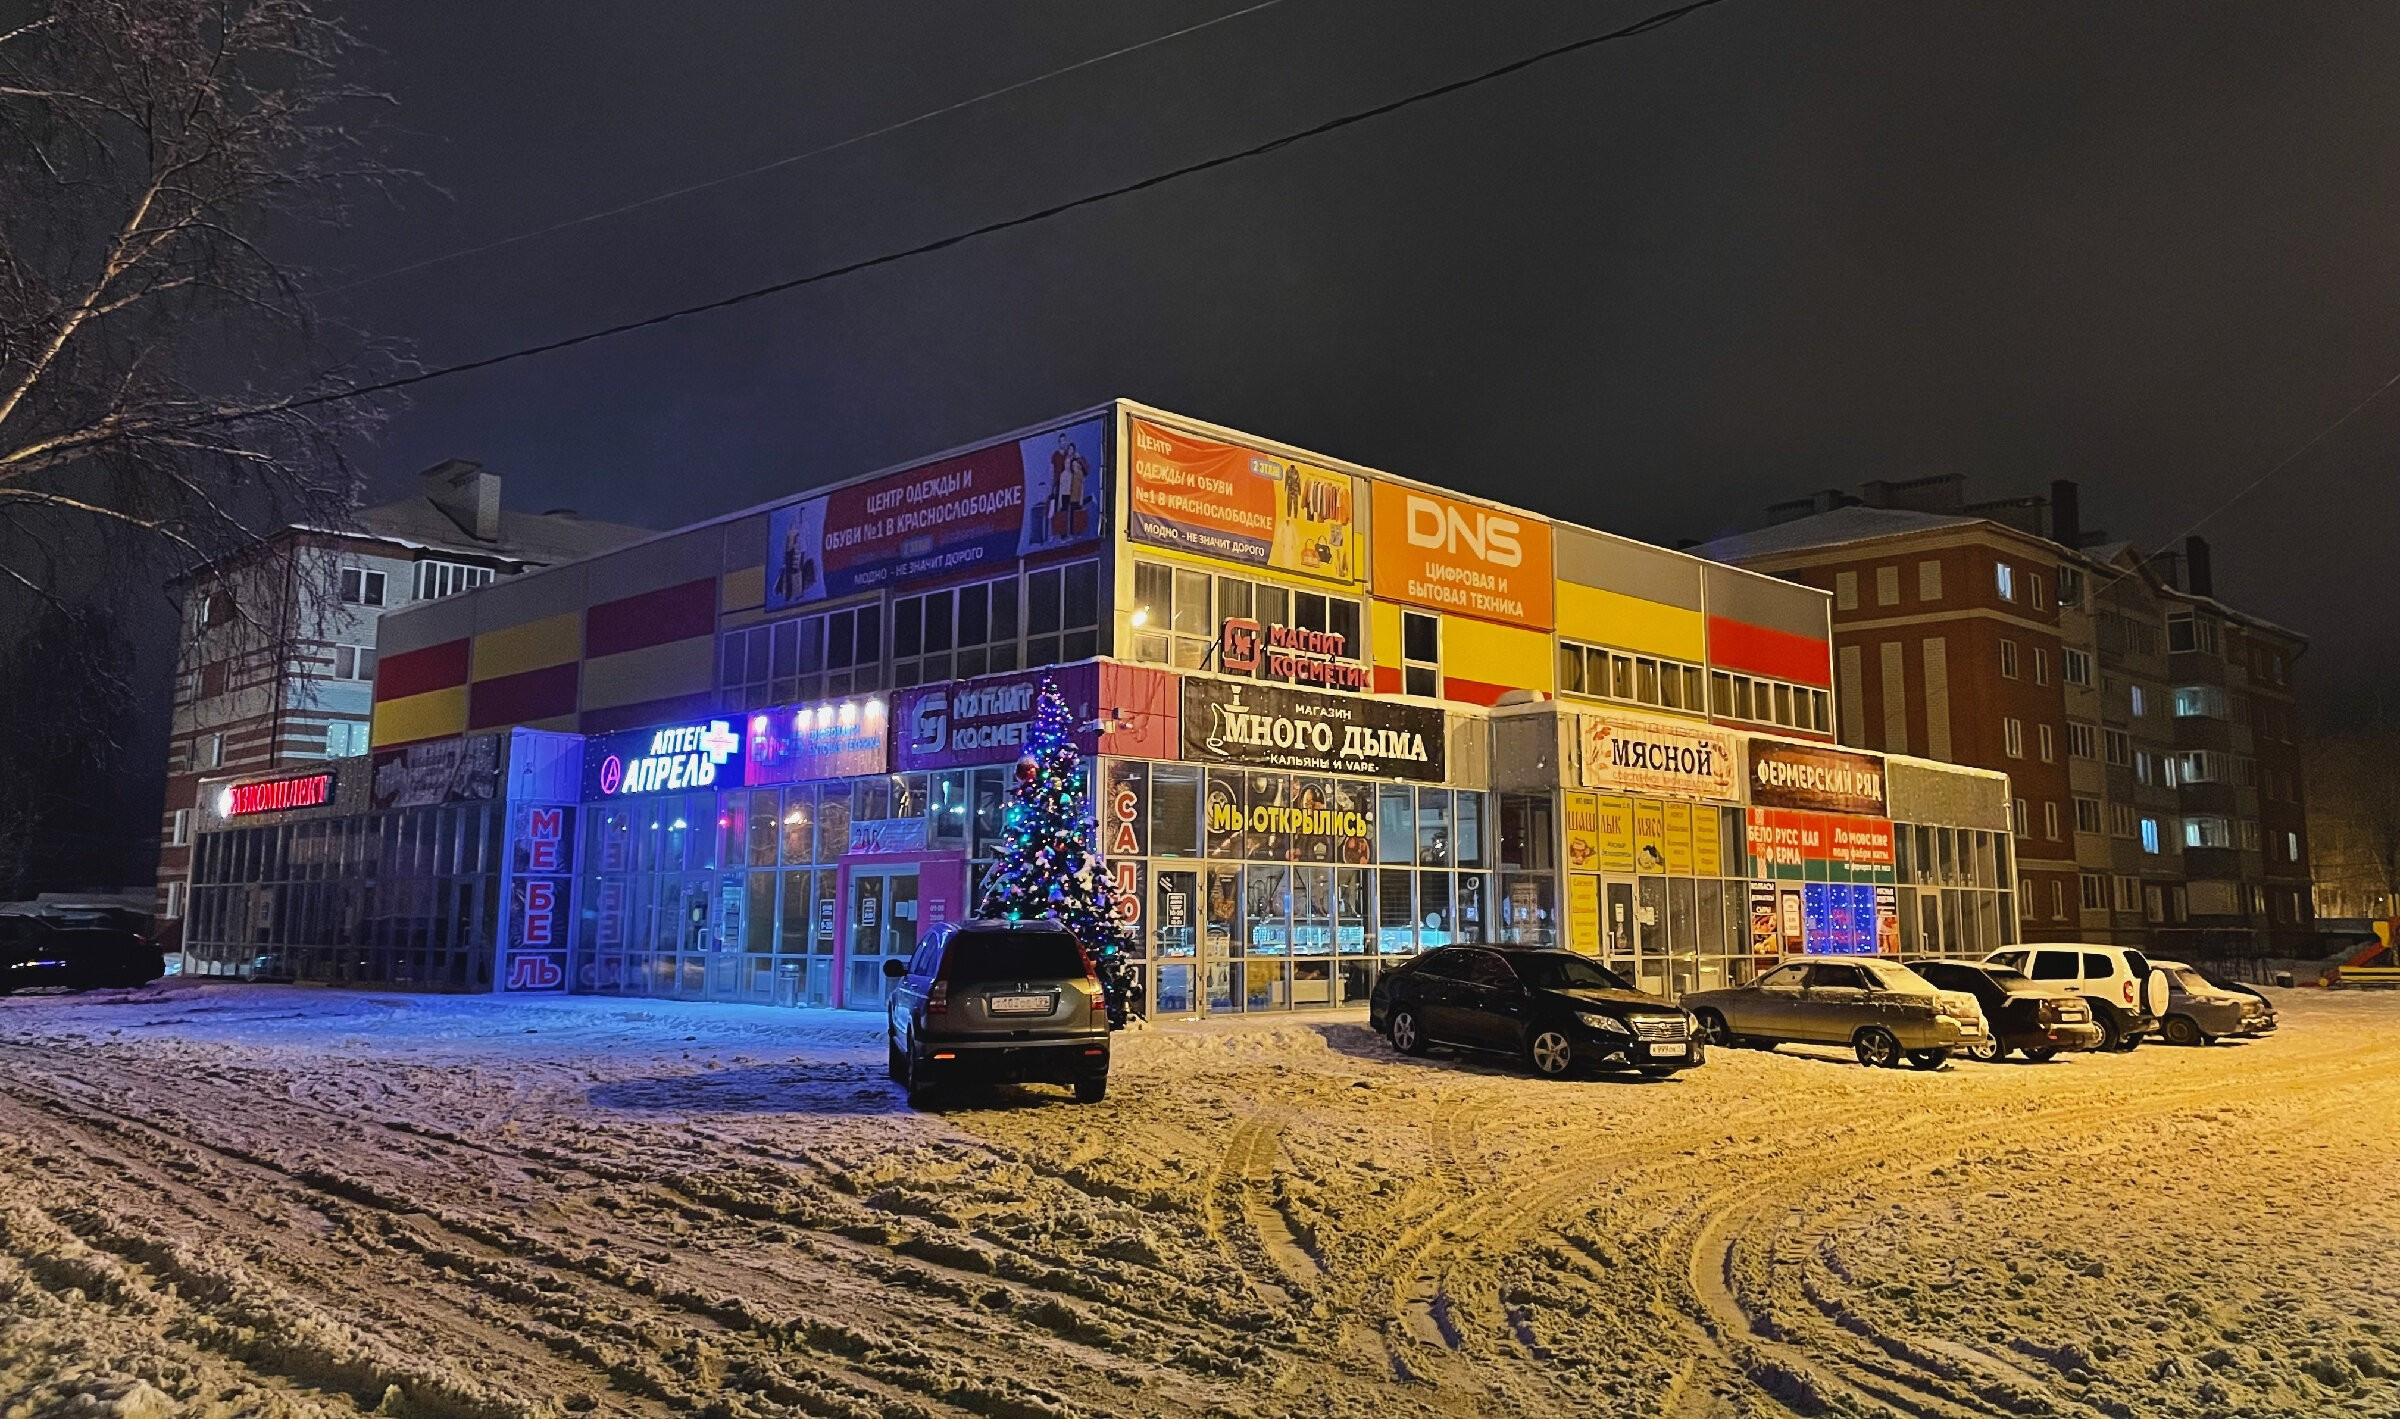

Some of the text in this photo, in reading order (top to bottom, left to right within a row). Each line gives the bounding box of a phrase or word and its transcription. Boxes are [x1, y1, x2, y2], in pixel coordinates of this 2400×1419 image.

[1137, 432, 1171, 455] ЦЕНТР
[1136, 460, 1233, 496] ОДЕЖДЫ И ОБУВИ
[1253, 461, 1259, 471] 2
[867, 470, 972, 515] ЦЕНТР ОДЕЖДЫ И
[1136, 486, 1273, 530] №1 В КРАСНОСЛОБОДСКЕ
[825, 525, 861, 551] ОБУВИ
[864, 522, 883, 542] №1
[886, 517, 894, 536] В
[897, 485, 1022, 534] КРАСНОСЛОБОДСКЕ
[1407, 495, 1522, 568] DNS
[1144, 523, 1178, 538] МОДНО
[1187, 532, 1198, 543] НЕ
[1199, 535, 1230, 550] ЗНАЧИТ
[1232, 542, 1265, 557] ДОРОГО
[854, 568, 887, 585] МОДНО
[896, 563, 907, 576] НЕ
[908, 555, 943, 574] ЗНАЧИТ
[945, 547, 983, 567] ДОРОГО
[1425, 562, 1508, 593] ЦИФРОВАЯ И
[1408, 580, 1524, 617] БЫТОВАЯ ТЕХНИКА
[1270, 624, 1345, 656] МАГНИТ
[1270, 655, 1370, 688] КОСМЕТИК
[953, 685, 1034, 720] МАГНИТ
[1295, 704, 1352, 719] МАГАЗИН
[1223, 712, 1428, 762] МНОГО ДЫМА
[621, 752, 715, 794] АПРЕЛЬ
[1269, 753, 1329, 769] КАЛЬЯНЫ
[1333, 759, 1342, 770] И
[1611, 739, 1712, 776] МЯСНОЙ
[1757, 759, 1882, 802] ФЕРМЕРСКИЙ РЯД
[1214, 802, 1367, 837] МЫ ОТКРЫЛИСЬ
[1637, 817, 1662, 838] МЯСО
